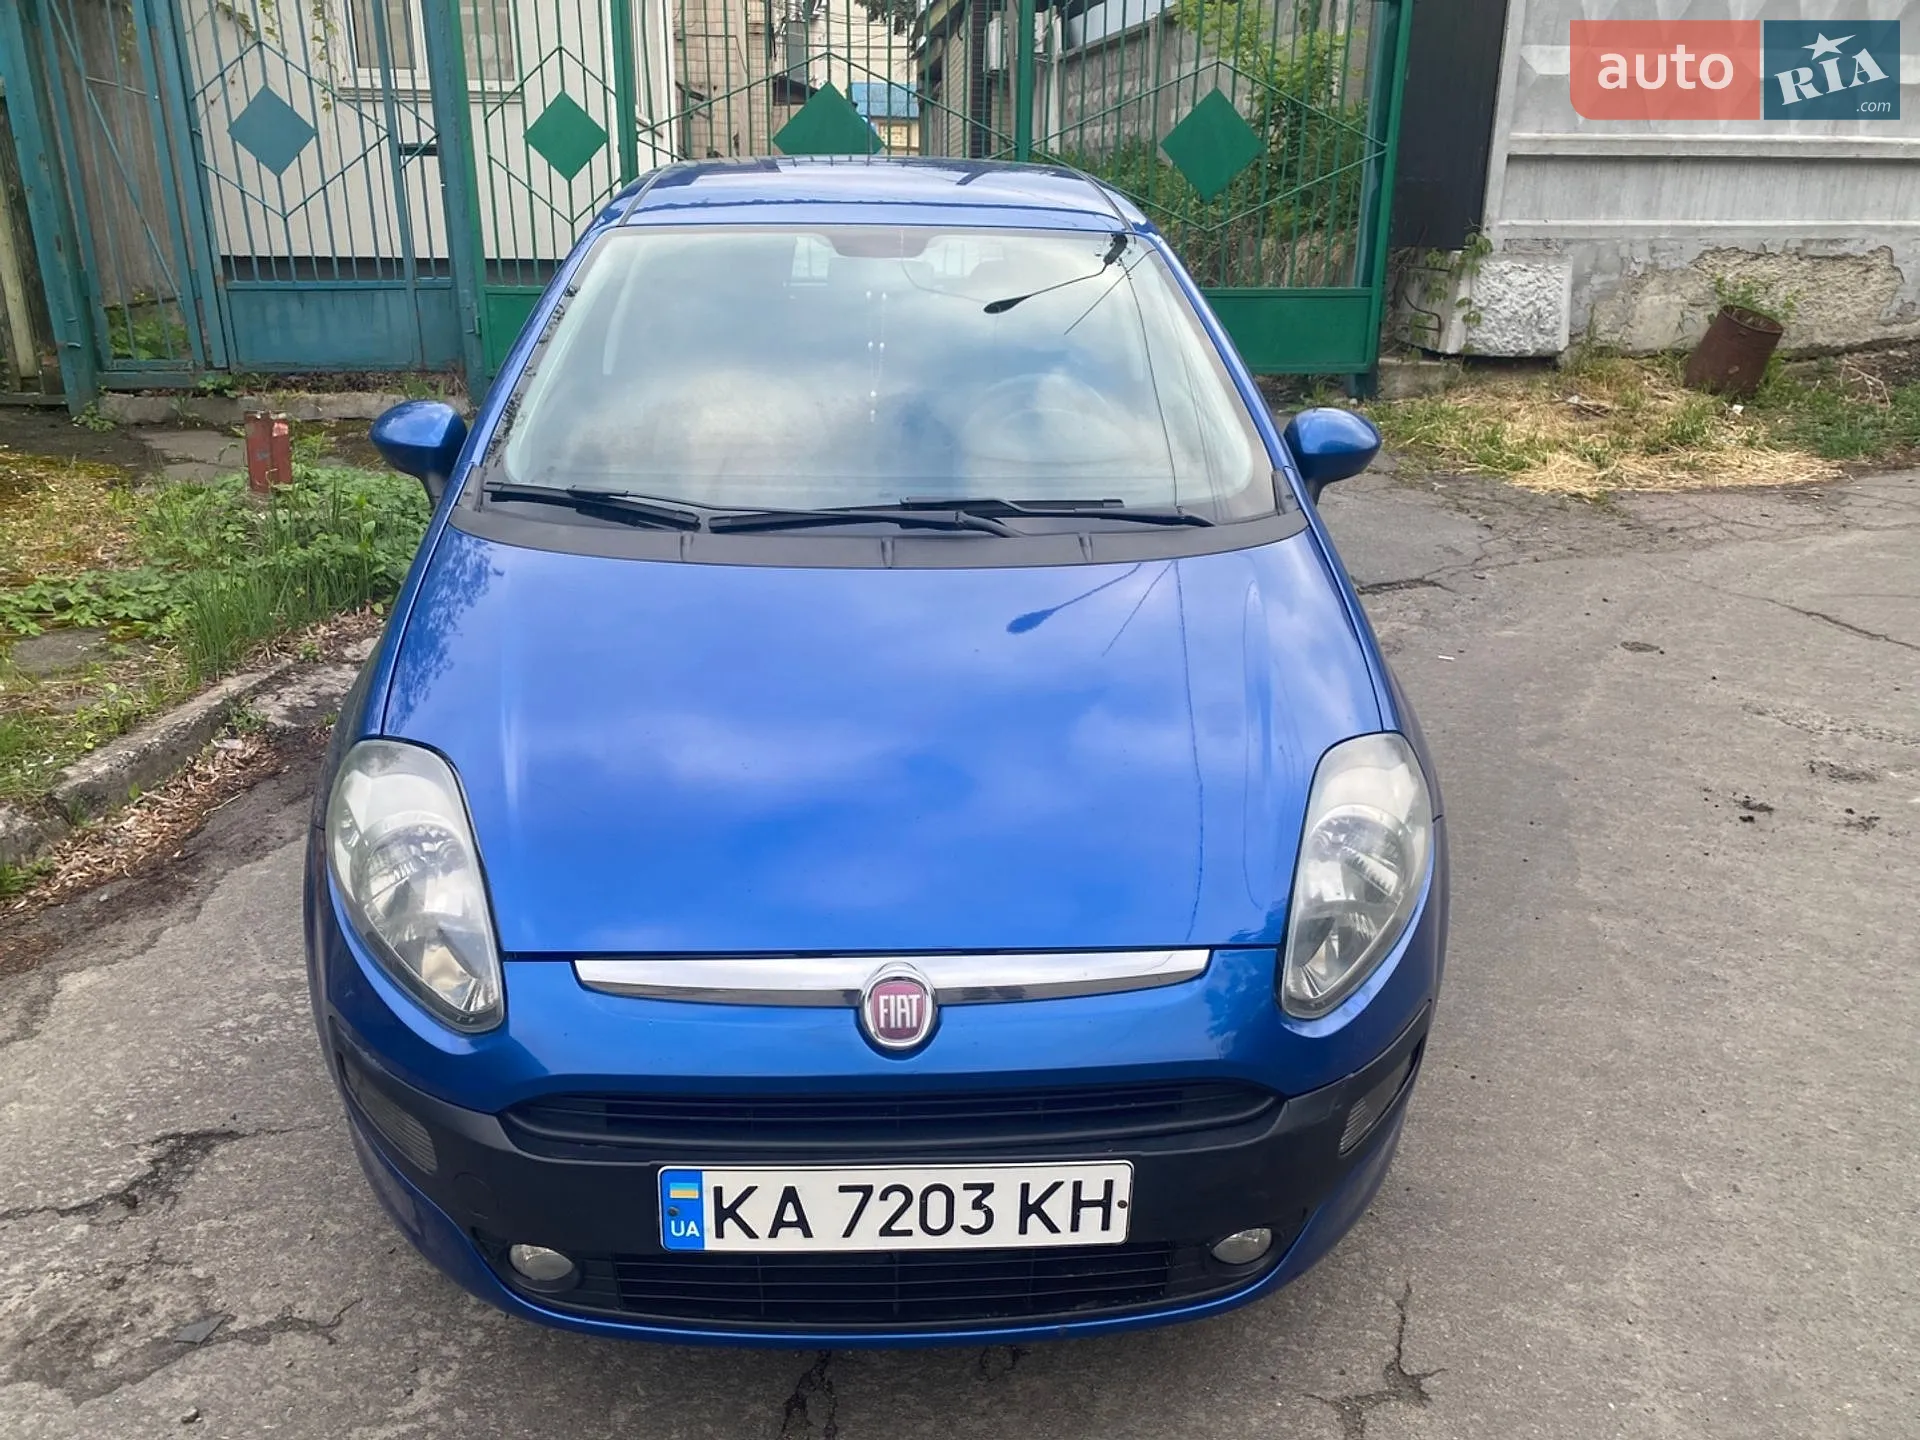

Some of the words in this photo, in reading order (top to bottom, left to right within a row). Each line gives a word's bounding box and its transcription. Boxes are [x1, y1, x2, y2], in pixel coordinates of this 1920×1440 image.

[879, 995, 920, 1028] FIAT
[712, 1185, 814, 1239] KA
[837, 1181, 995, 1238] 7203
[1017, 1178, 1114, 1235] KH
[670, 1219, 700, 1237] UA
